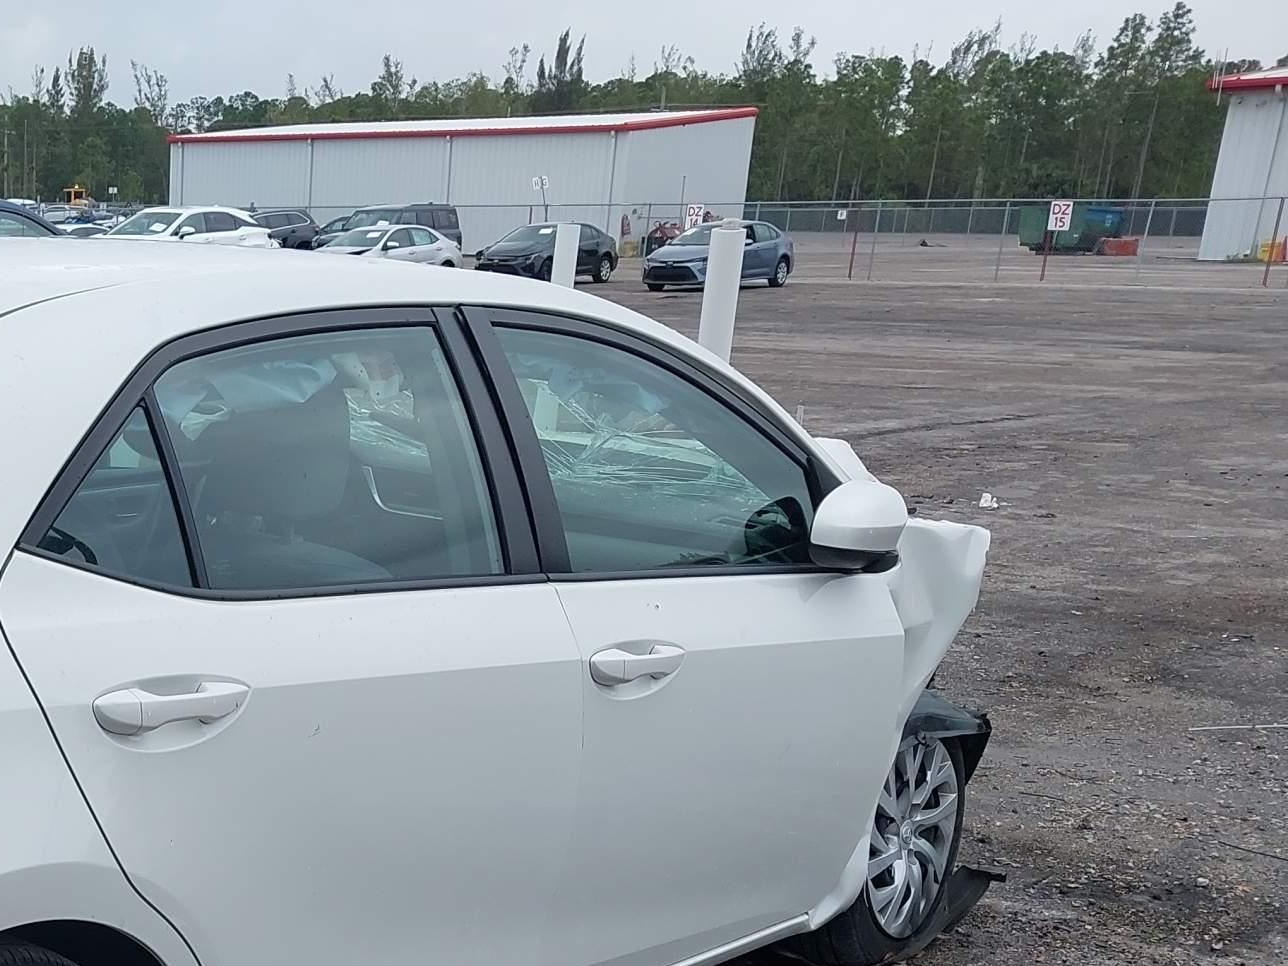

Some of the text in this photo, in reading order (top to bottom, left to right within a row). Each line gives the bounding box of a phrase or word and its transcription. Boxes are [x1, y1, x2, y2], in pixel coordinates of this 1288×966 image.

[688, 206, 703, 217] DZ
[1052, 203, 1071, 216] DZ
[1054, 216, 1066, 229] 15
